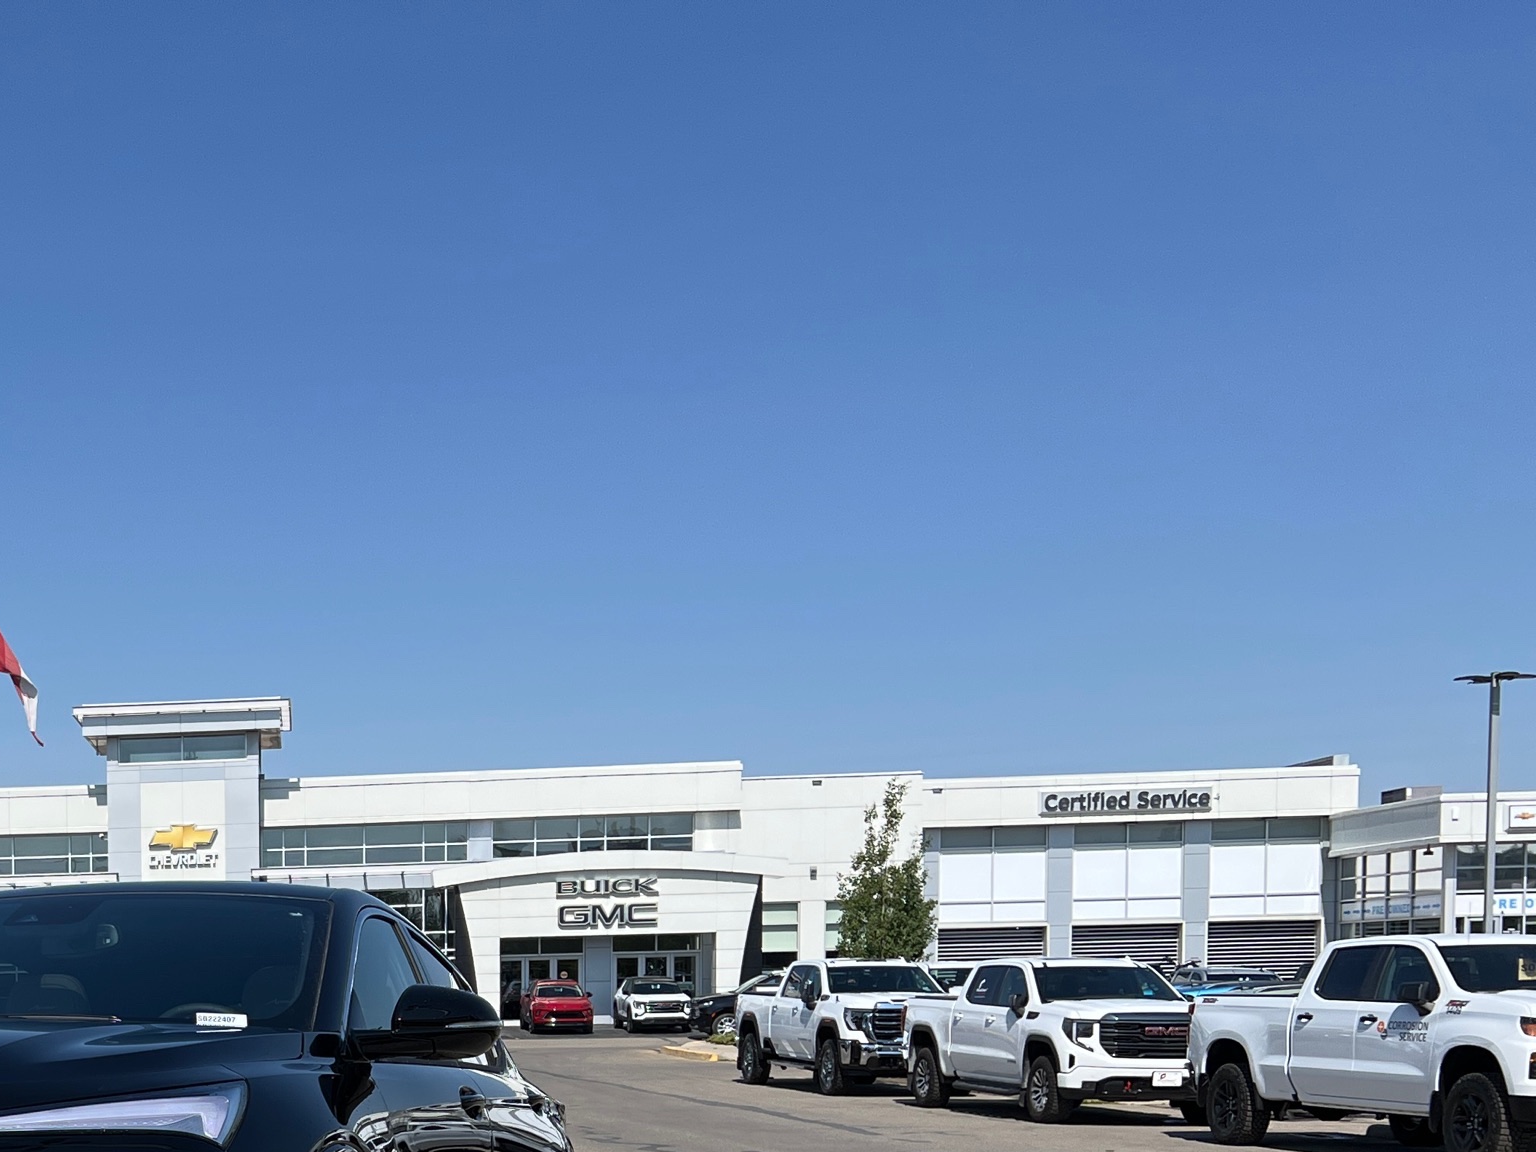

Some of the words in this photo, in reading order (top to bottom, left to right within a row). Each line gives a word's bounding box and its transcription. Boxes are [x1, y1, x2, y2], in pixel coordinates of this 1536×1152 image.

[1044, 791, 1130, 812] Certified
[1136, 789, 1211, 809] Service
[148, 853, 219, 870] CHEVROLET
[556, 876, 659, 899] BUICK
[558, 903, 658, 930] GMC
[1145, 1027, 1189, 1036] GMC
[1388, 1020, 1429, 1032] CORROSION
[1398, 1032, 1427, 1043] SERVICE
